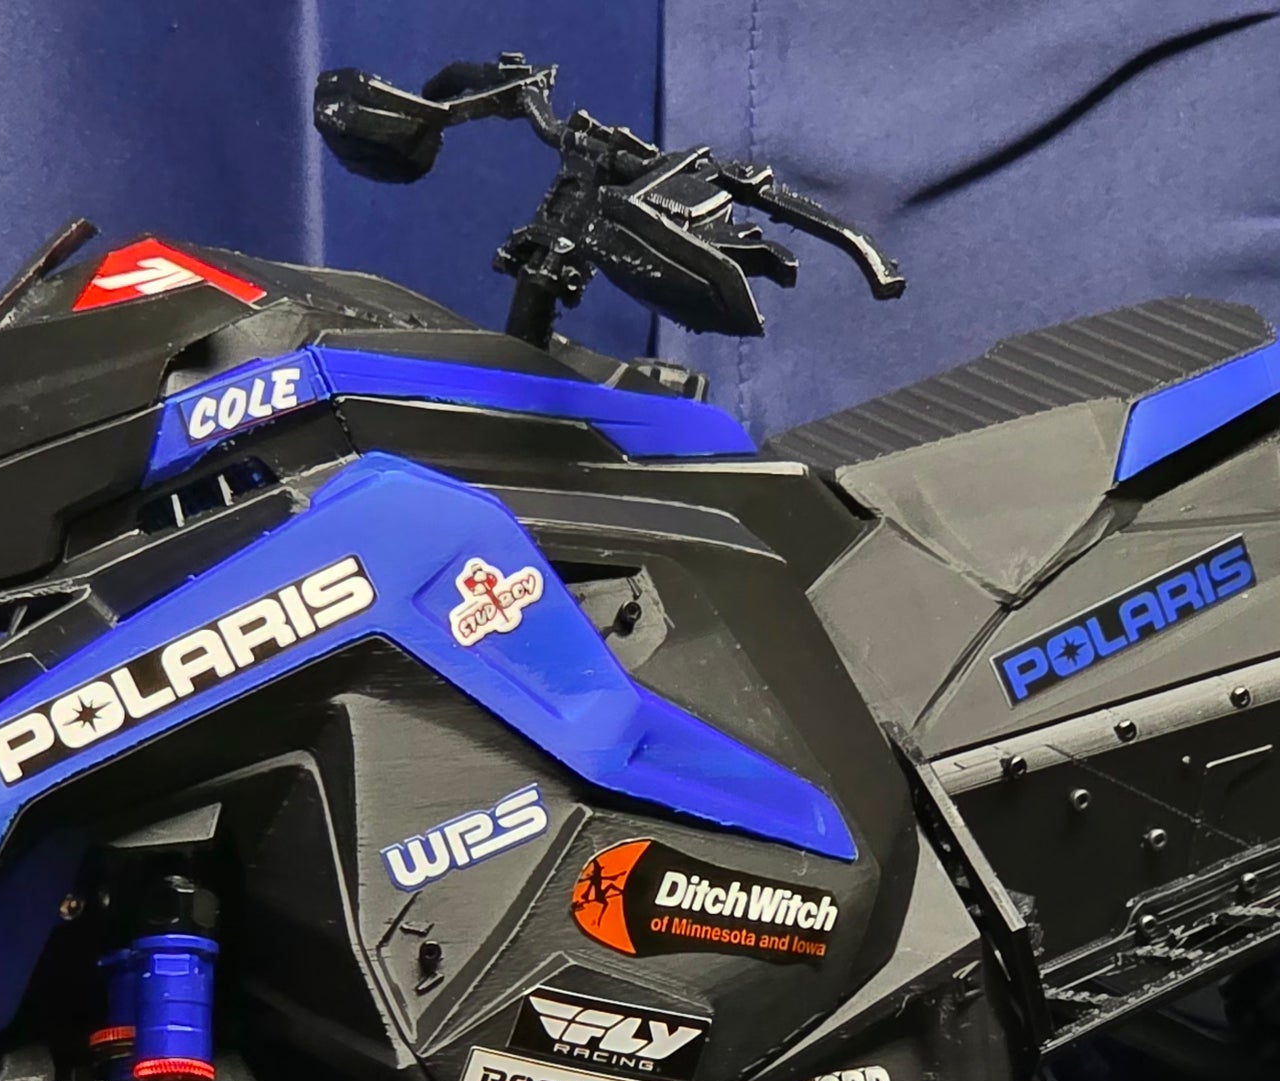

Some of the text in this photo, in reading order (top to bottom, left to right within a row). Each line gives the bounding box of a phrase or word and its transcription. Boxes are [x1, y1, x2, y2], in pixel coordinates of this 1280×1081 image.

[189, 368, 301, 439] COLE
[458, 574, 536, 639] STUD BOY
[1002, 544, 1253, 700] POLARIS
[383, 786, 549, 887] WPS
[650, 916, 827, 956] of Minnesota and Iowa
[529, 995, 703, 1060] FLY
[553, 1042, 655, 1072] RACING
